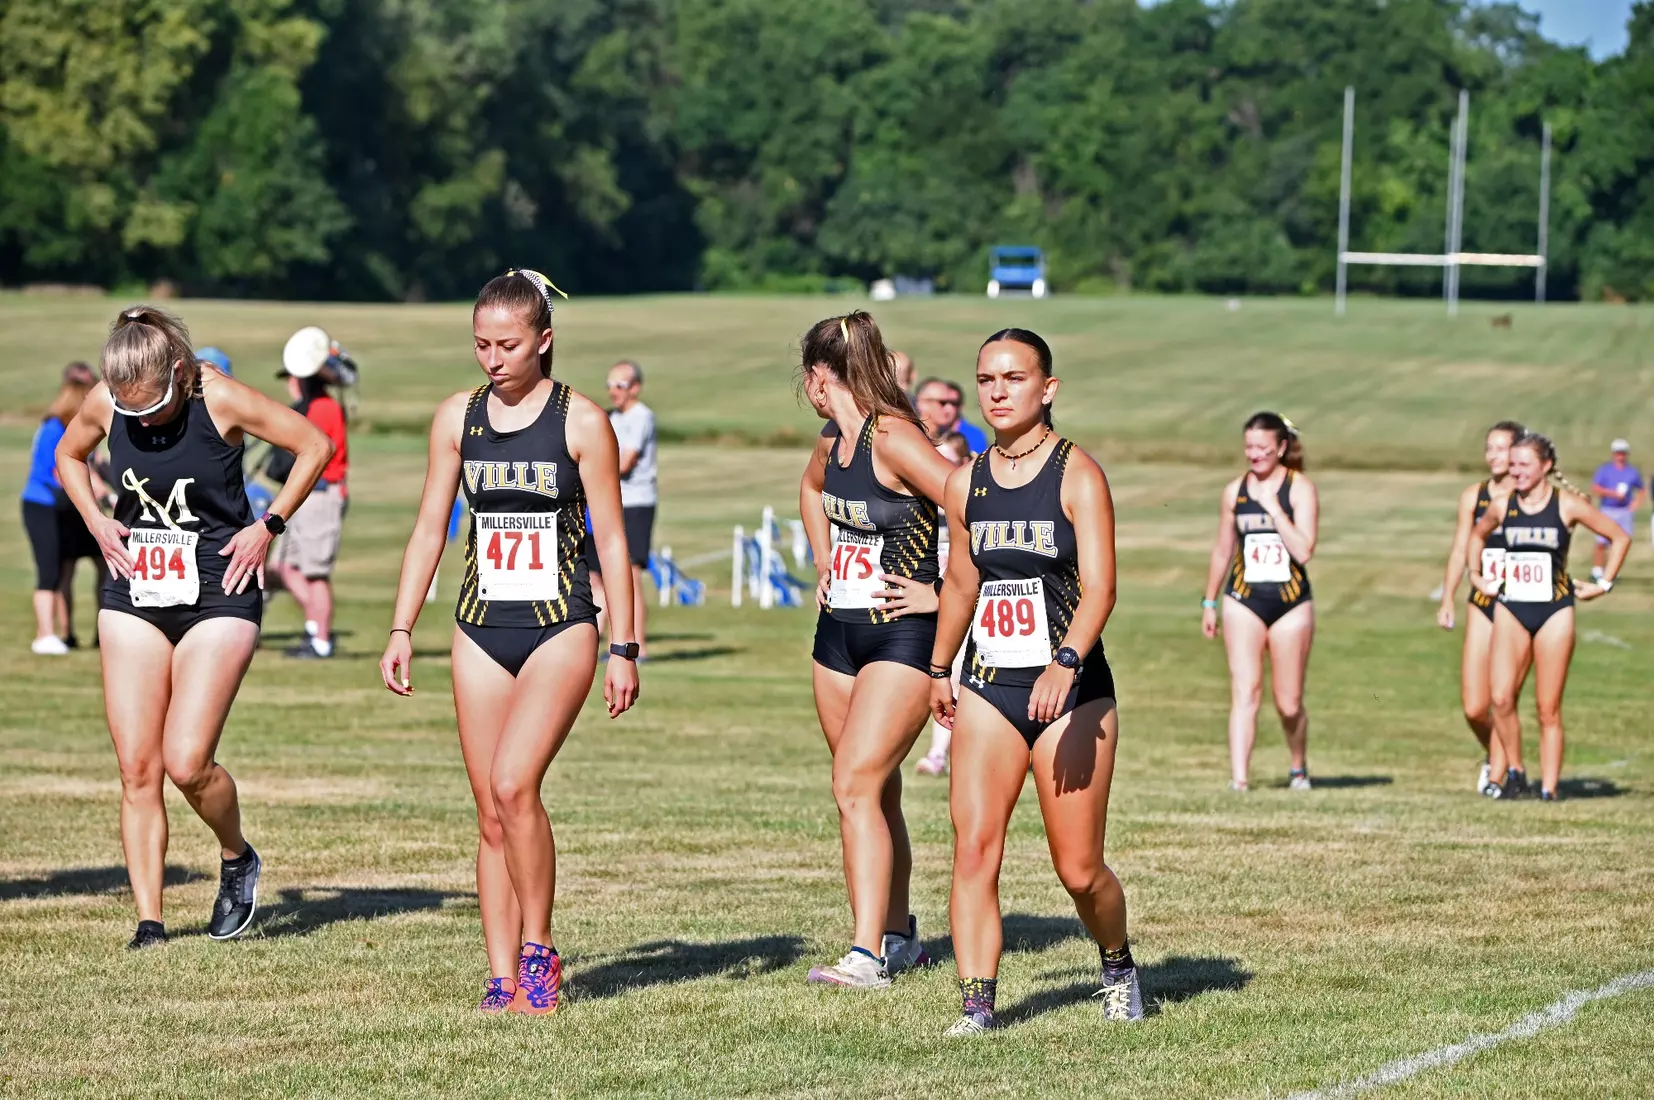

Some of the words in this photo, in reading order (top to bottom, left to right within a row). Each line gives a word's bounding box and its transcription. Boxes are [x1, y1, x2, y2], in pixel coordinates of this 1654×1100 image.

[464, 461, 558, 499] VILLE
[481, 516, 551, 530] MILLERSVILLE
[822, 490, 876, 531] ILLE
[132, 531, 193, 546] MILLERSVILLE
[487, 531, 543, 570] 471
[970, 520, 1058, 558] VILLE
[1251, 544, 1283, 565] 473
[1504, 526, 1559, 549] VILLE
[133, 546, 186, 581] 494
[833, 544, 873, 581] 475
[1513, 564, 1543, 583] 480
[982, 581, 1039, 597] MILLERSVILLE
[980, 598, 1036, 637] 489
